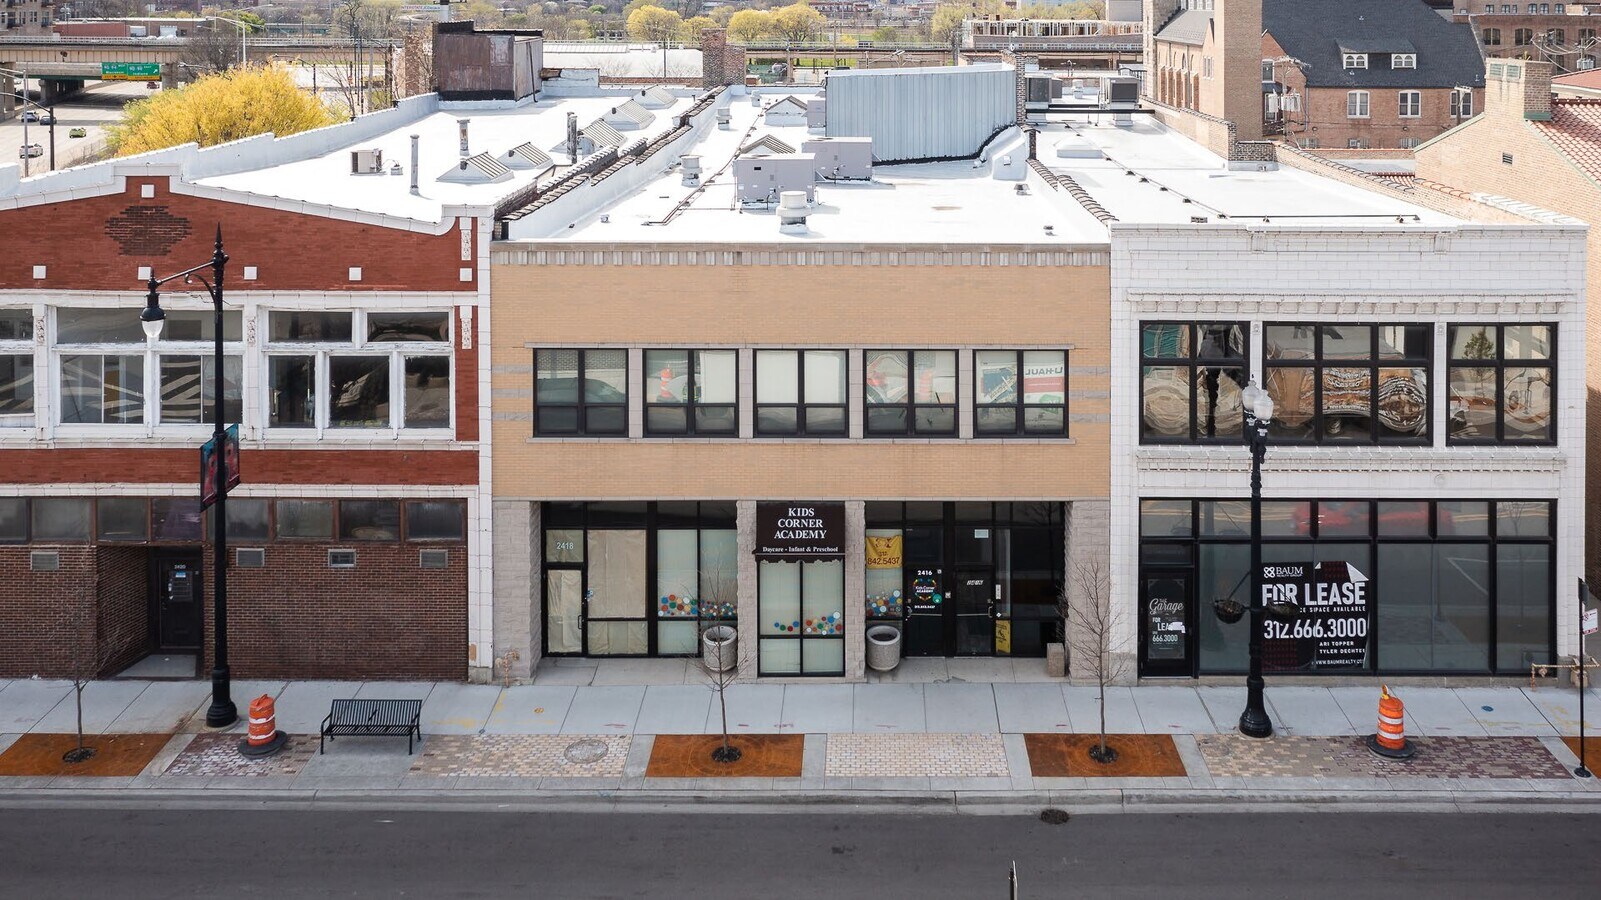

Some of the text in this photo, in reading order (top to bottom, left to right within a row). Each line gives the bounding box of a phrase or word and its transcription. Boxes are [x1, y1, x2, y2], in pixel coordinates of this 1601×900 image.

[788, 507, 815, 517] KIDS
[777, 518, 823, 528] CORNER
[774, 529, 827, 539] ACADEMY
[556, 541, 574, 550] 2418
[867, 556, 900, 565] 842.5437
[1275, 566, 1304, 575] BAUM
[1261, 582, 1366, 607] FOR LEASE
[1149, 598, 1184, 615] Garage
[1264, 618, 1367, 639] 312.666.3000
